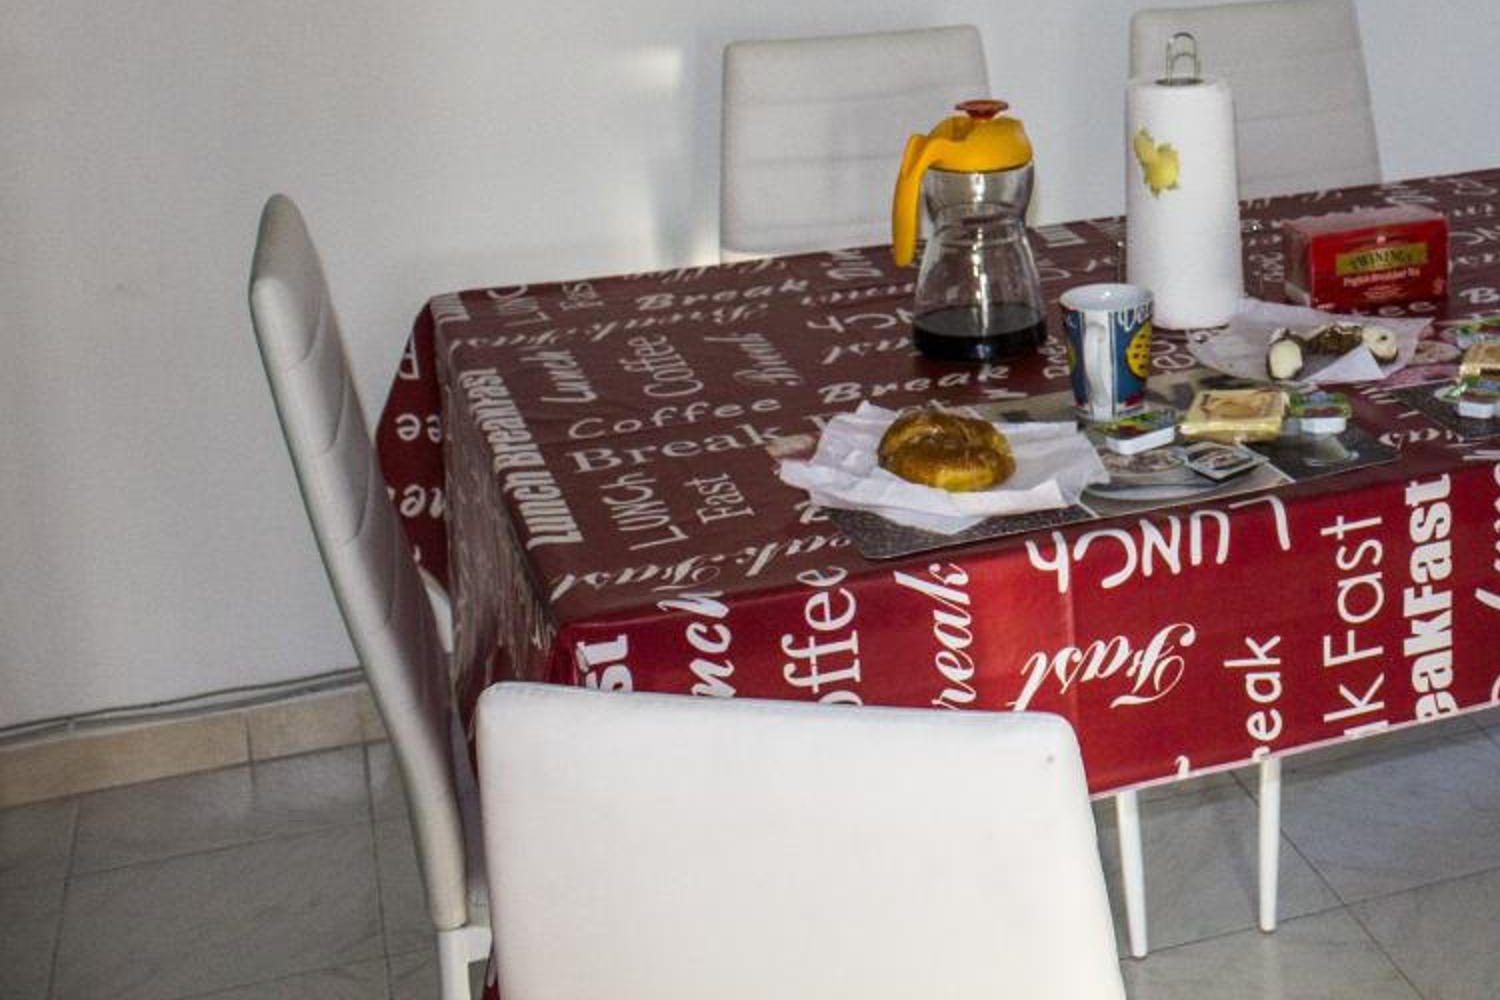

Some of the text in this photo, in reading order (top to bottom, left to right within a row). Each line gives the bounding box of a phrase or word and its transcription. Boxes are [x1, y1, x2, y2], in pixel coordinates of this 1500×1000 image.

[564, 423, 784, 474] Break
[567, 399, 783, 440] Coffee
[682, 472, 756, 525] Fast
[780, 564, 865, 707] ffee
[894, 562, 980, 712] reak
[1006, 622, 1197, 712] Fast
